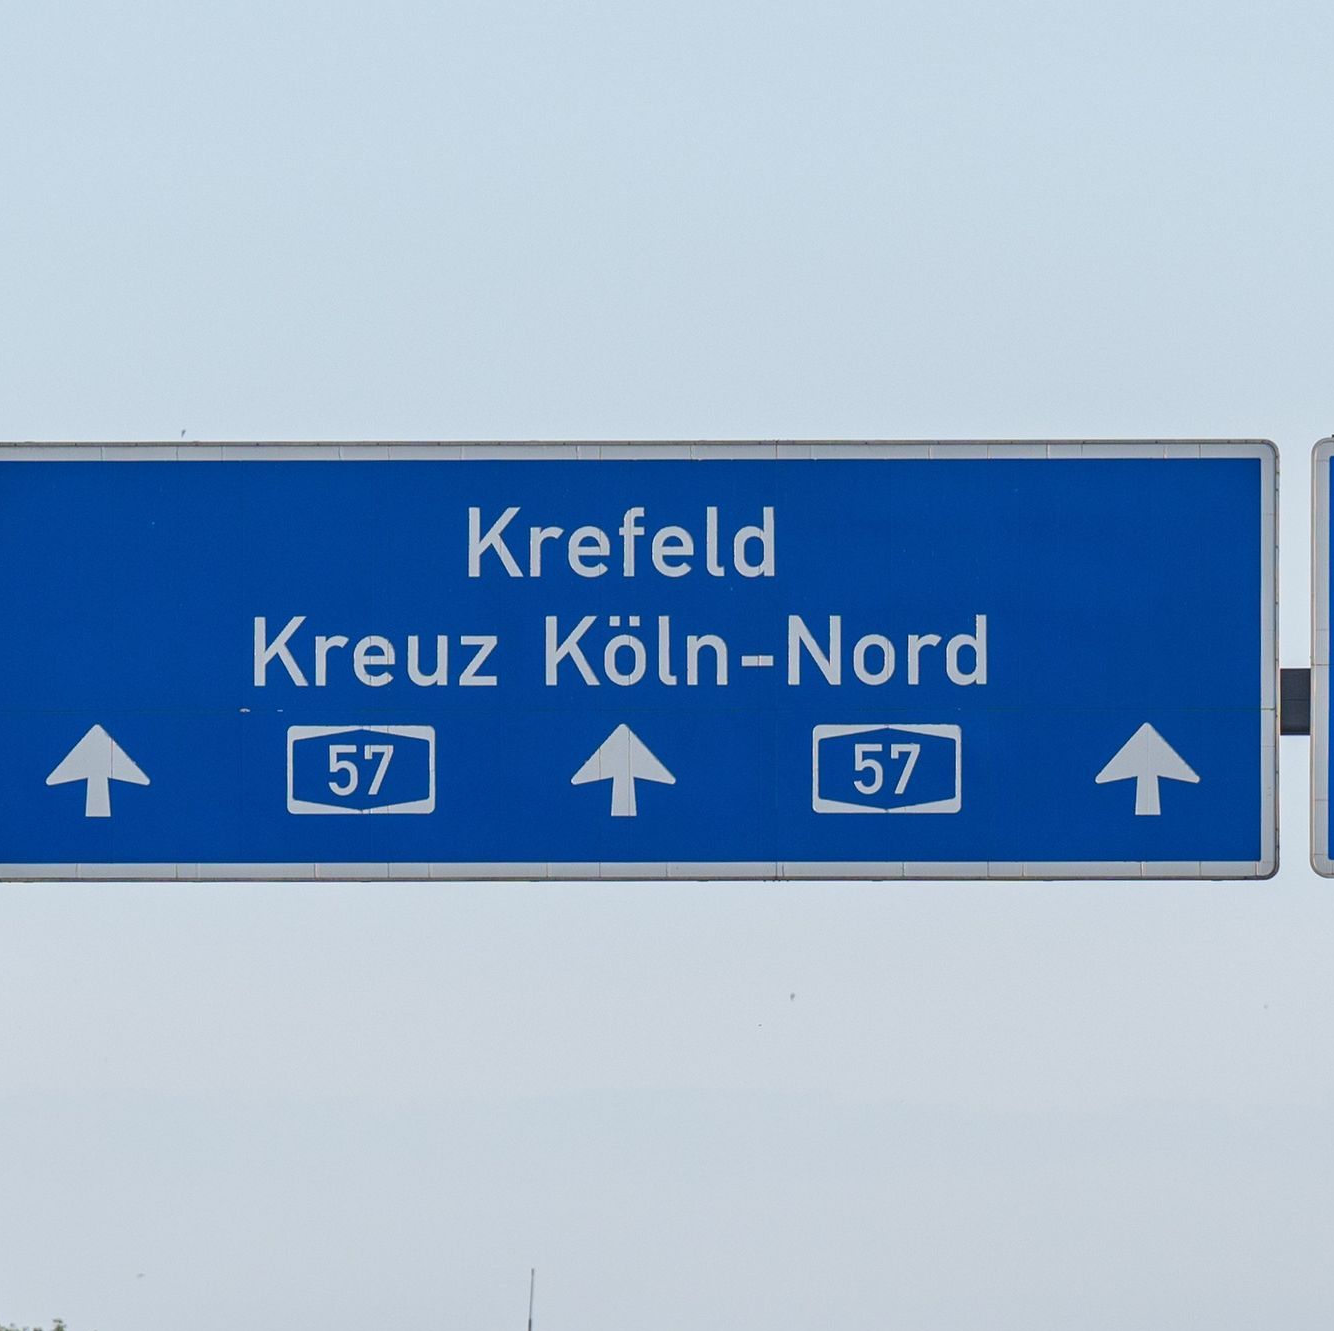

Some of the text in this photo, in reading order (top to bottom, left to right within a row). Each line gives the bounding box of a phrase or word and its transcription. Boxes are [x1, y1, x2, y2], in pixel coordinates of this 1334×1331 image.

[468, 506, 775, 578] Krefeld
[253, 614, 988, 687] Kreuz Köln-Nord
[326, 744, 394, 796] 57
[852, 743, 921, 795] 57
